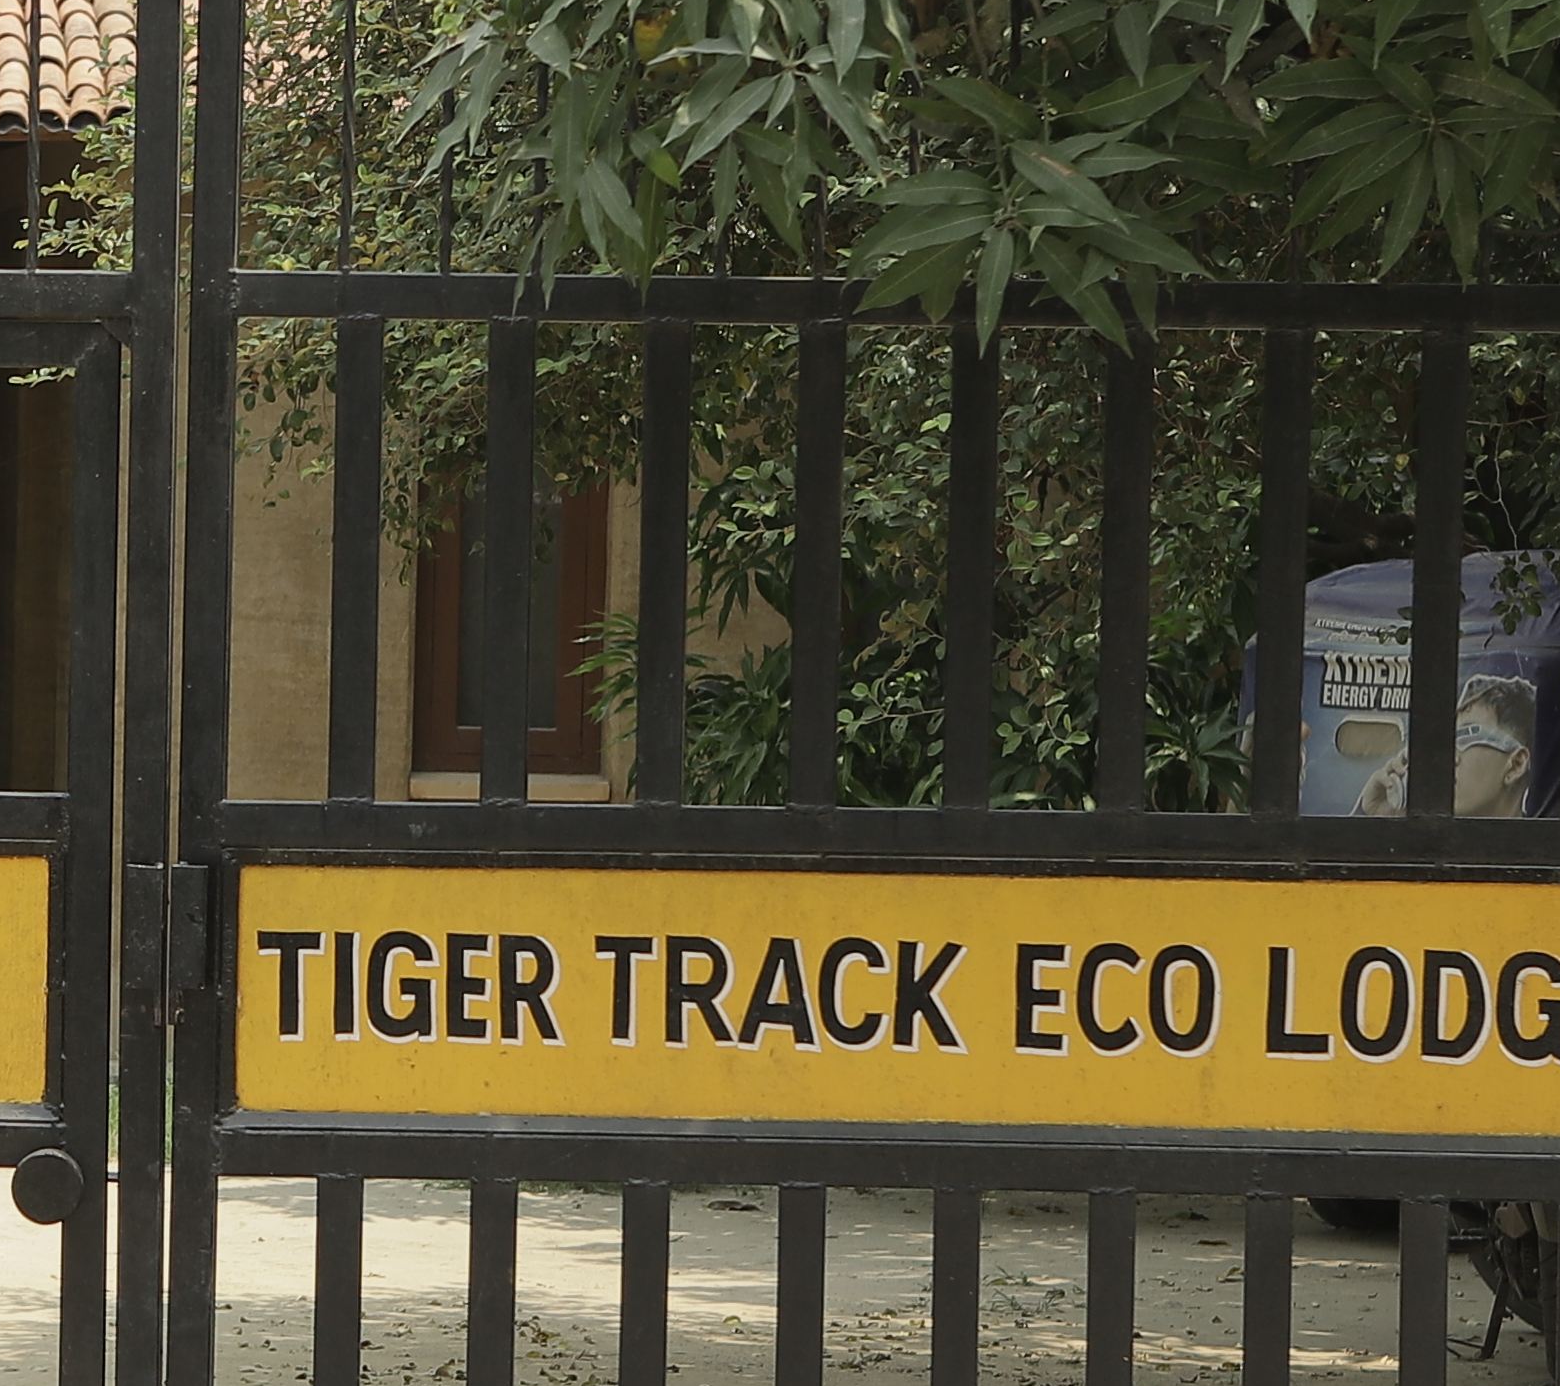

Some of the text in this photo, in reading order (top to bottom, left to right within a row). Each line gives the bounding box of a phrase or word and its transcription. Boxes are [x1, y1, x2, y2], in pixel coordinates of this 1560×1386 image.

[1323, 650, 1411, 685] XTREM
[1322, 684, 1411, 709] ENERGY DRI
[256, 929, 566, 1045] TIGER
[594, 934, 968, 1055] TRACK
[1015, 942, 1222, 1058] ECO
